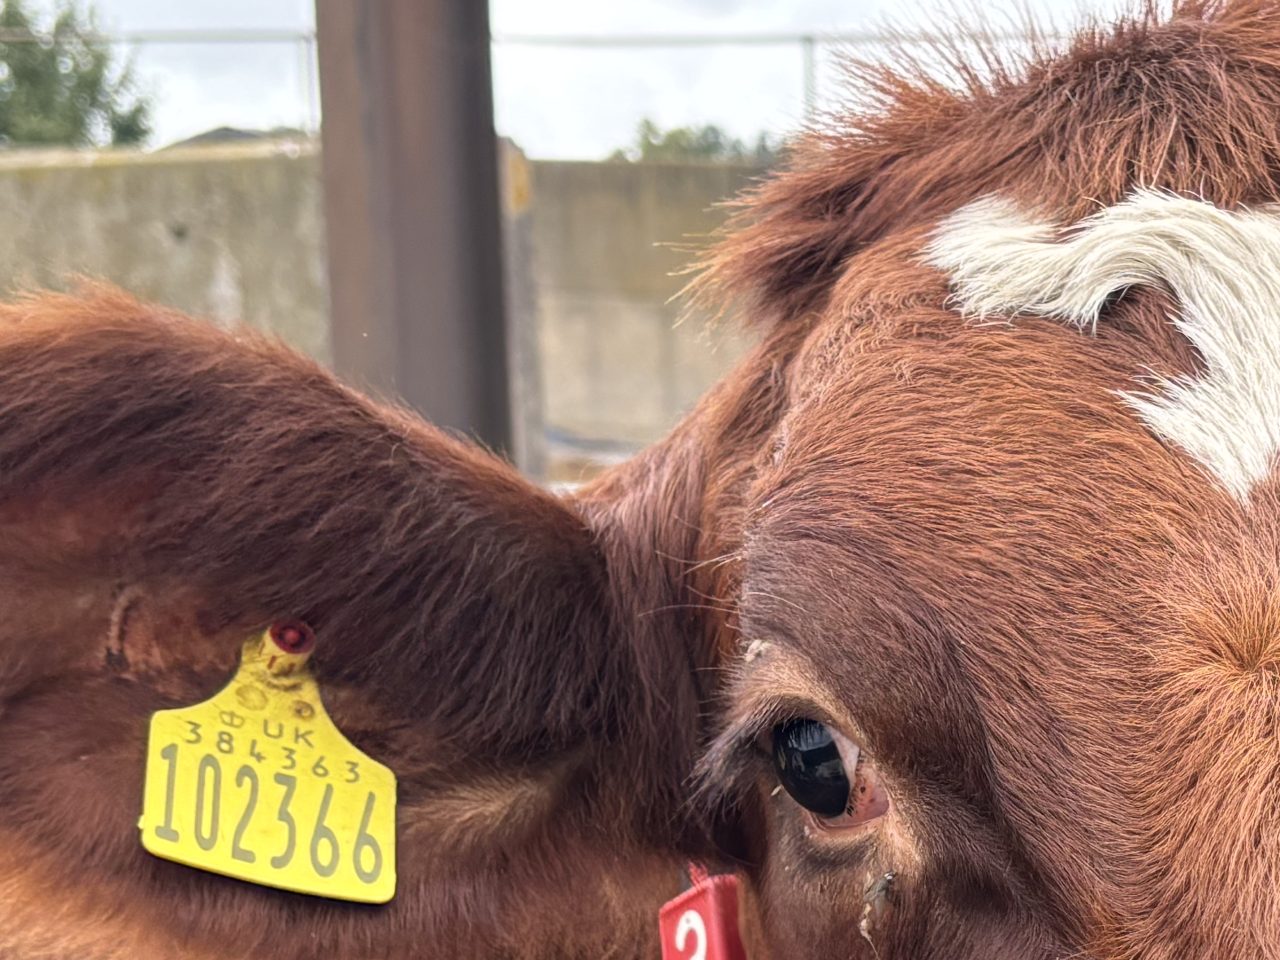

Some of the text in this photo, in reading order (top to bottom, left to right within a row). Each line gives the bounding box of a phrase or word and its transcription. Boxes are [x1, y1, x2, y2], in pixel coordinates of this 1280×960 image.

[184, 721, 361, 783] 384363
[263, 719, 314, 749] UK
[154, 743, 383, 884] 102366
